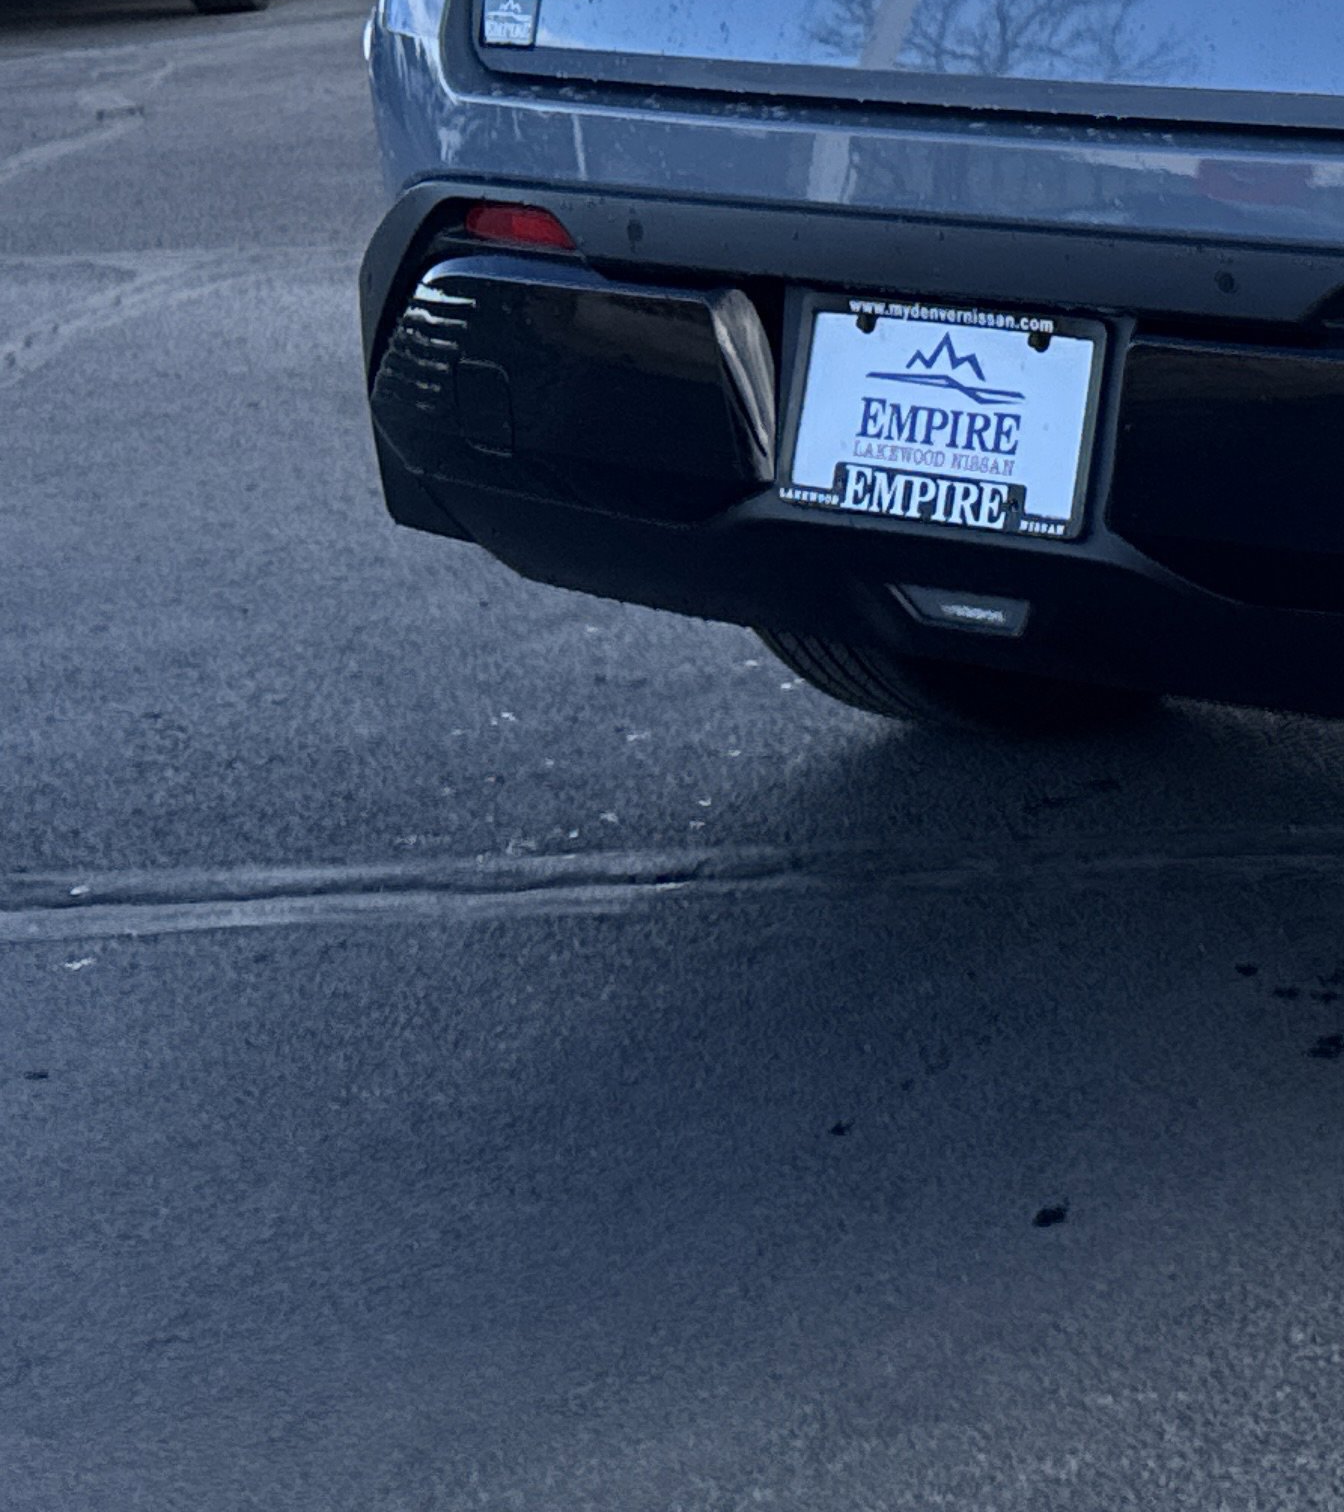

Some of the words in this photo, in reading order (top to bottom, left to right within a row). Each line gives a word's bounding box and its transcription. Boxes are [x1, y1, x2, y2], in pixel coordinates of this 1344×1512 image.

[849, 299, 1054, 333] www.mydenvernissan.com
[855, 396, 1021, 455] EMPIRE
[852, 439, 945, 467] LAKEWOOD
[950, 452, 1016, 477] NISSAN
[840, 464, 1009, 530] EMPIRE
[1019, 519, 1065, 536] NISSAN
